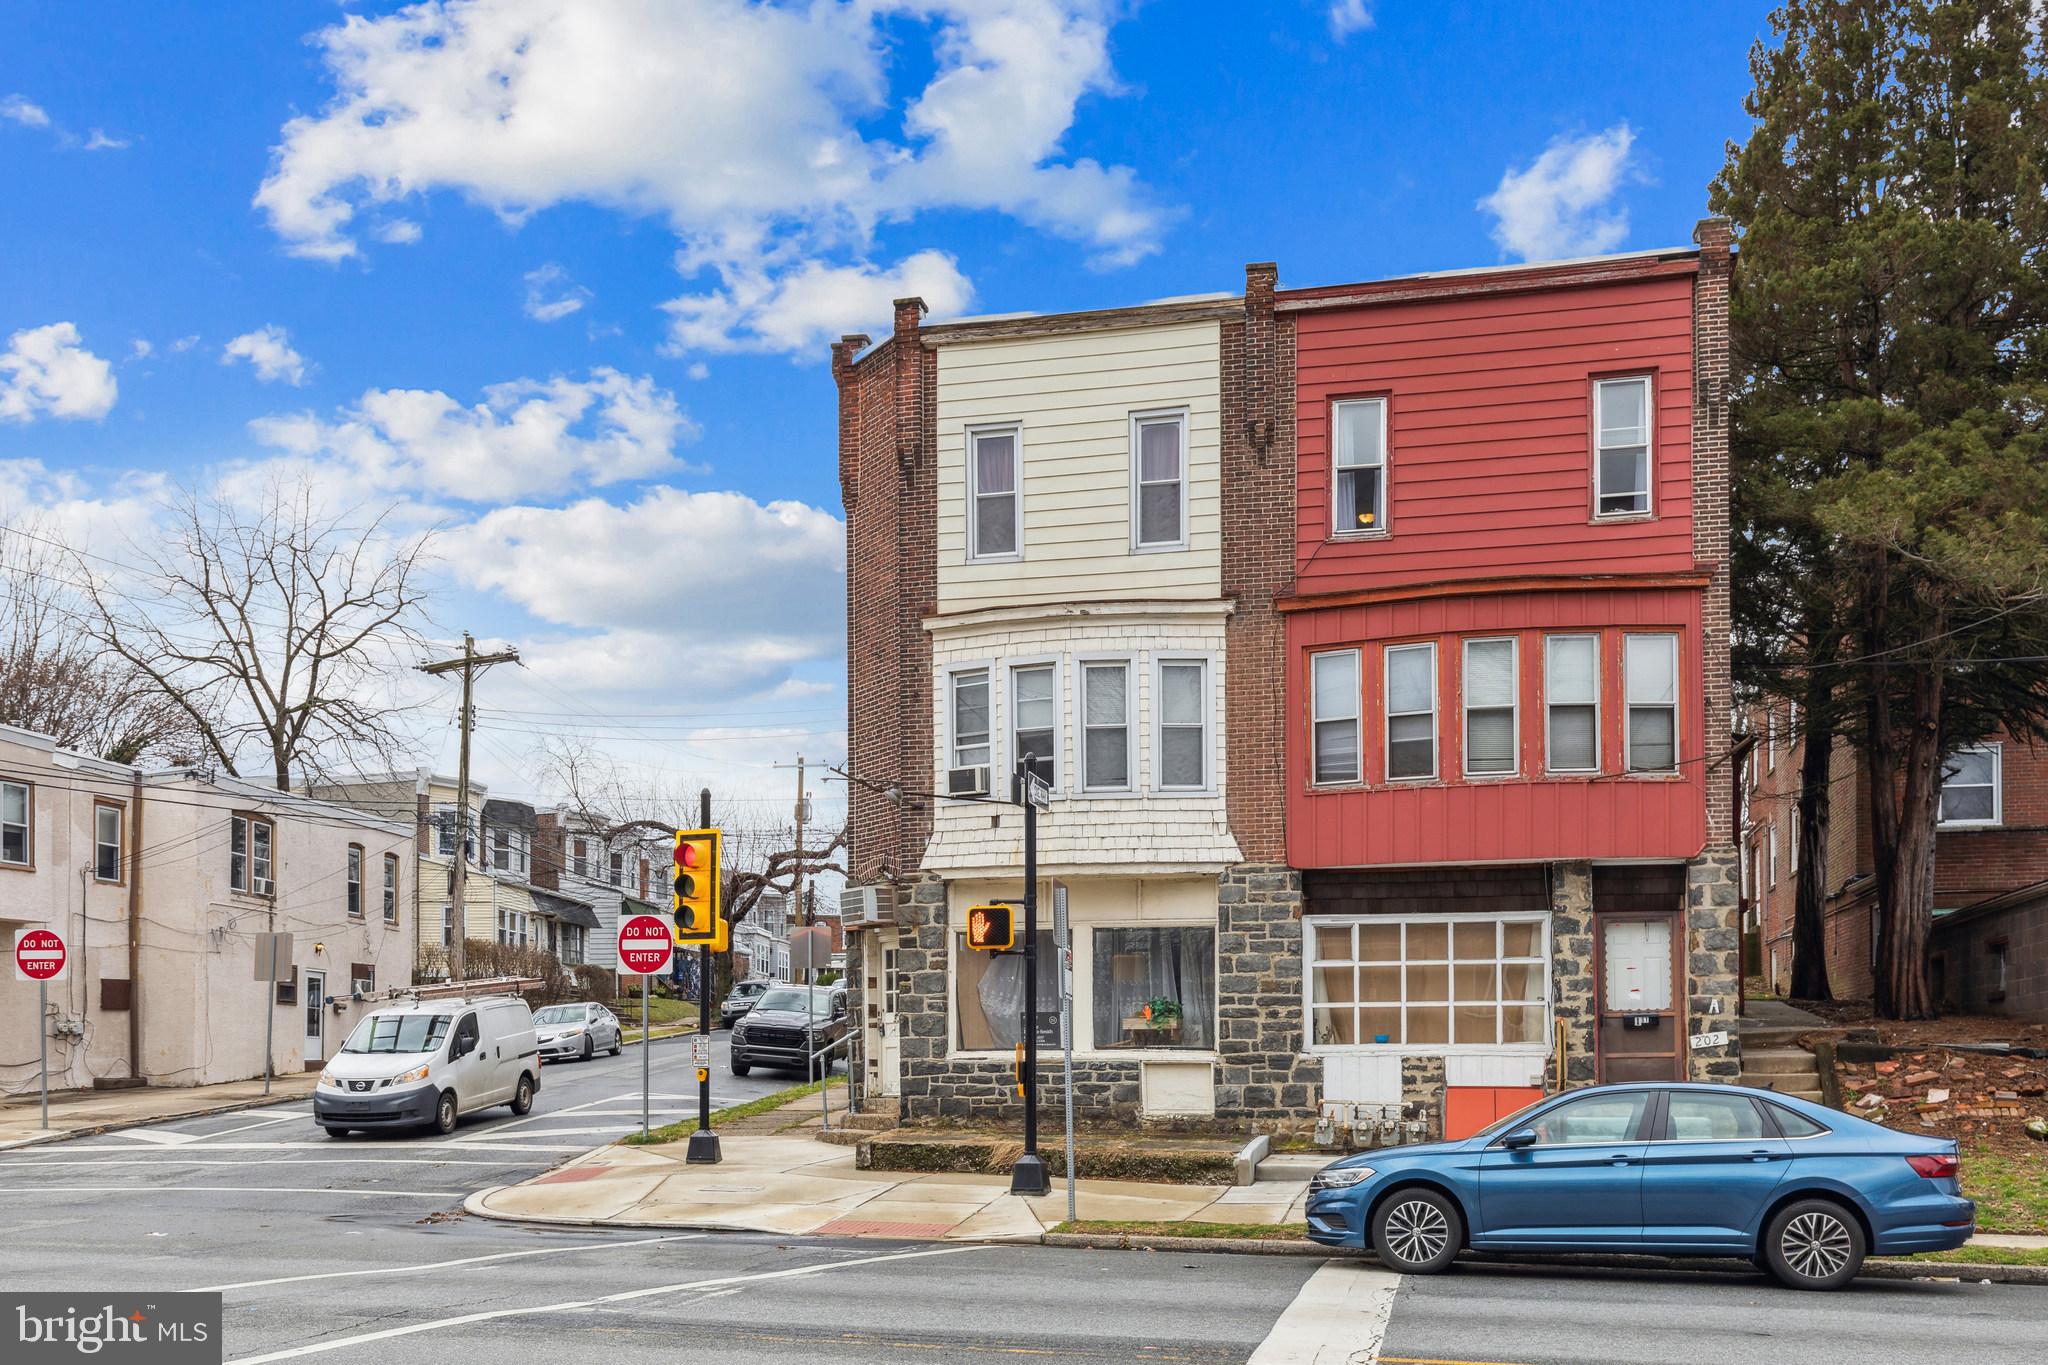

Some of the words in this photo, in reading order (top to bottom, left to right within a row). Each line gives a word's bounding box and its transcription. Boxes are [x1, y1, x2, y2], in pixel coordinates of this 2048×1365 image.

[627, 927, 640, 937] DO
[645, 927, 664, 936] NOT
[23, 940, 36, 948] DO
[41, 939, 59, 948] NOT
[630, 953, 660, 962] ENTER
[27, 961, 56, 970] ENTER
[1709, 999, 1720, 1014] A
[1695, 1034, 1720, 1047] 202
